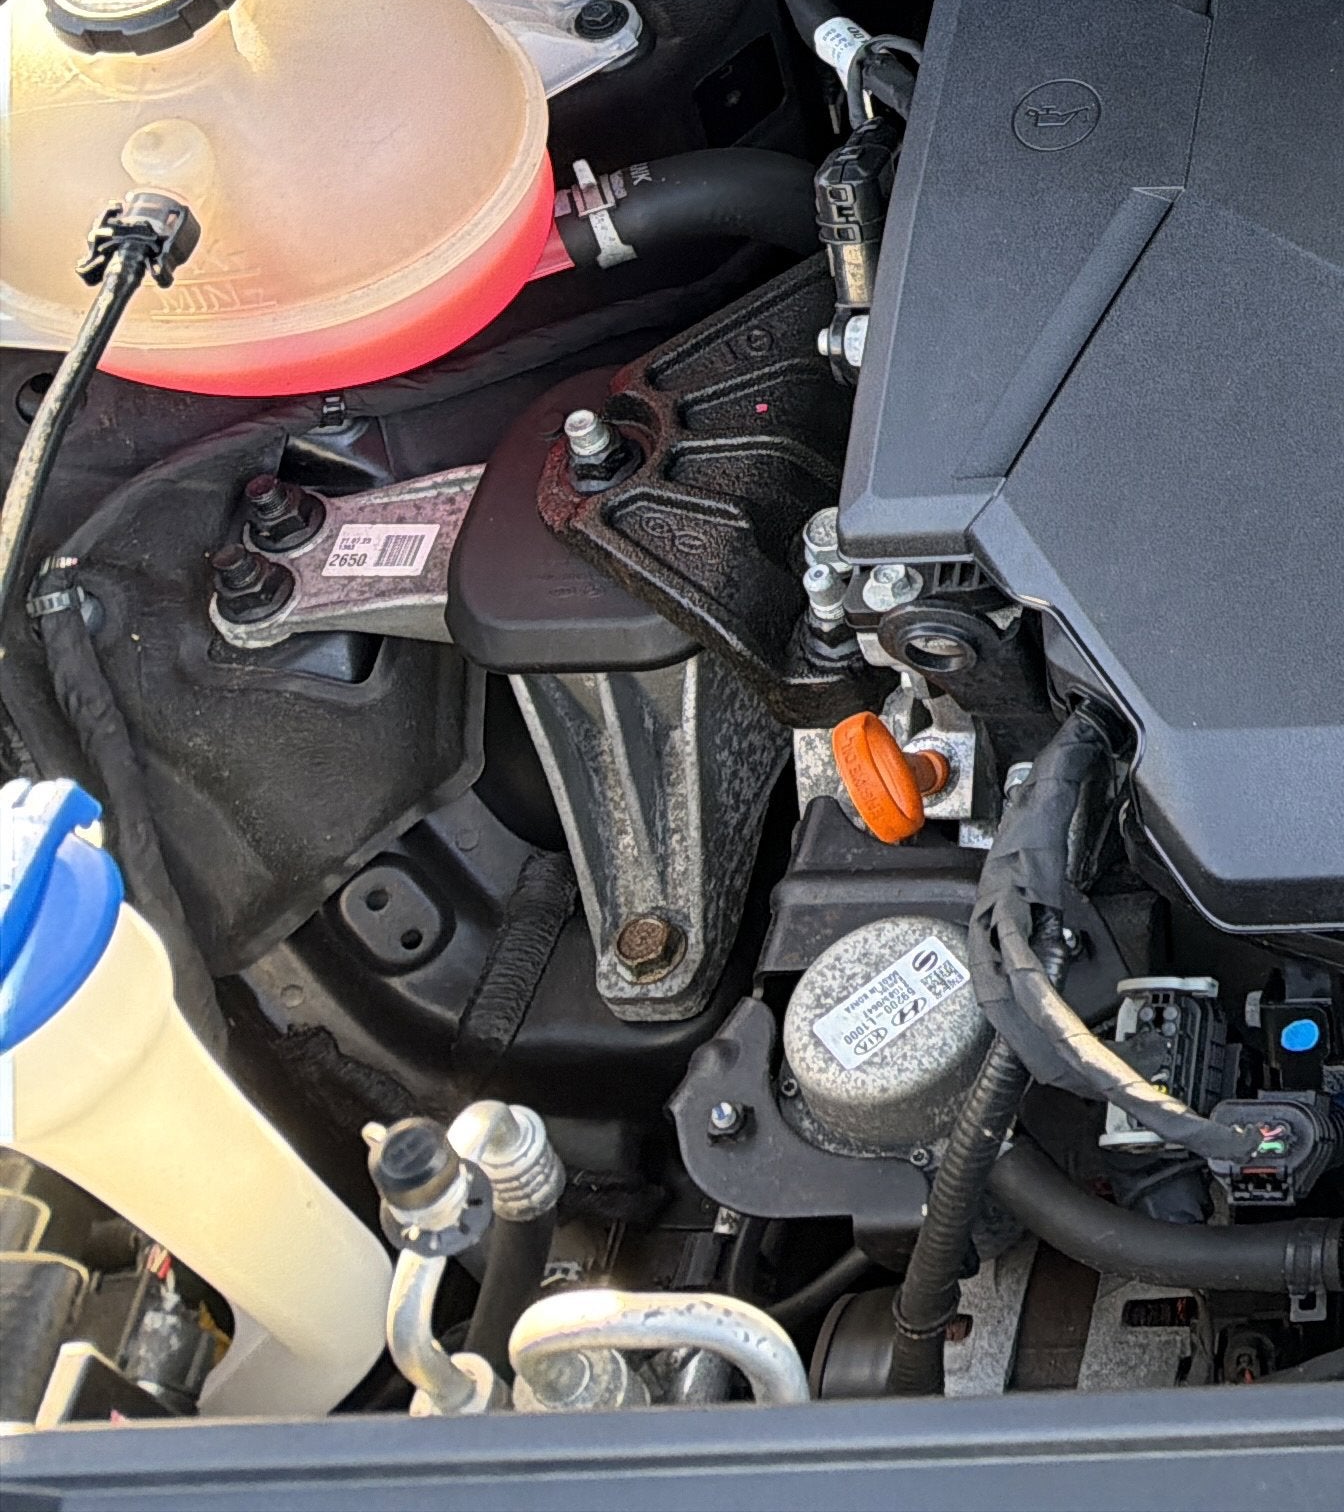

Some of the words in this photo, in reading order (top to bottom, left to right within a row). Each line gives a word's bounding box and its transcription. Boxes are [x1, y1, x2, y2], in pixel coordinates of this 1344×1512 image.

[329, 553, 367, 566] 2650
[842, 987, 915, 1045] 69200-L1000
[857, 1030, 882, 1052] KIA
